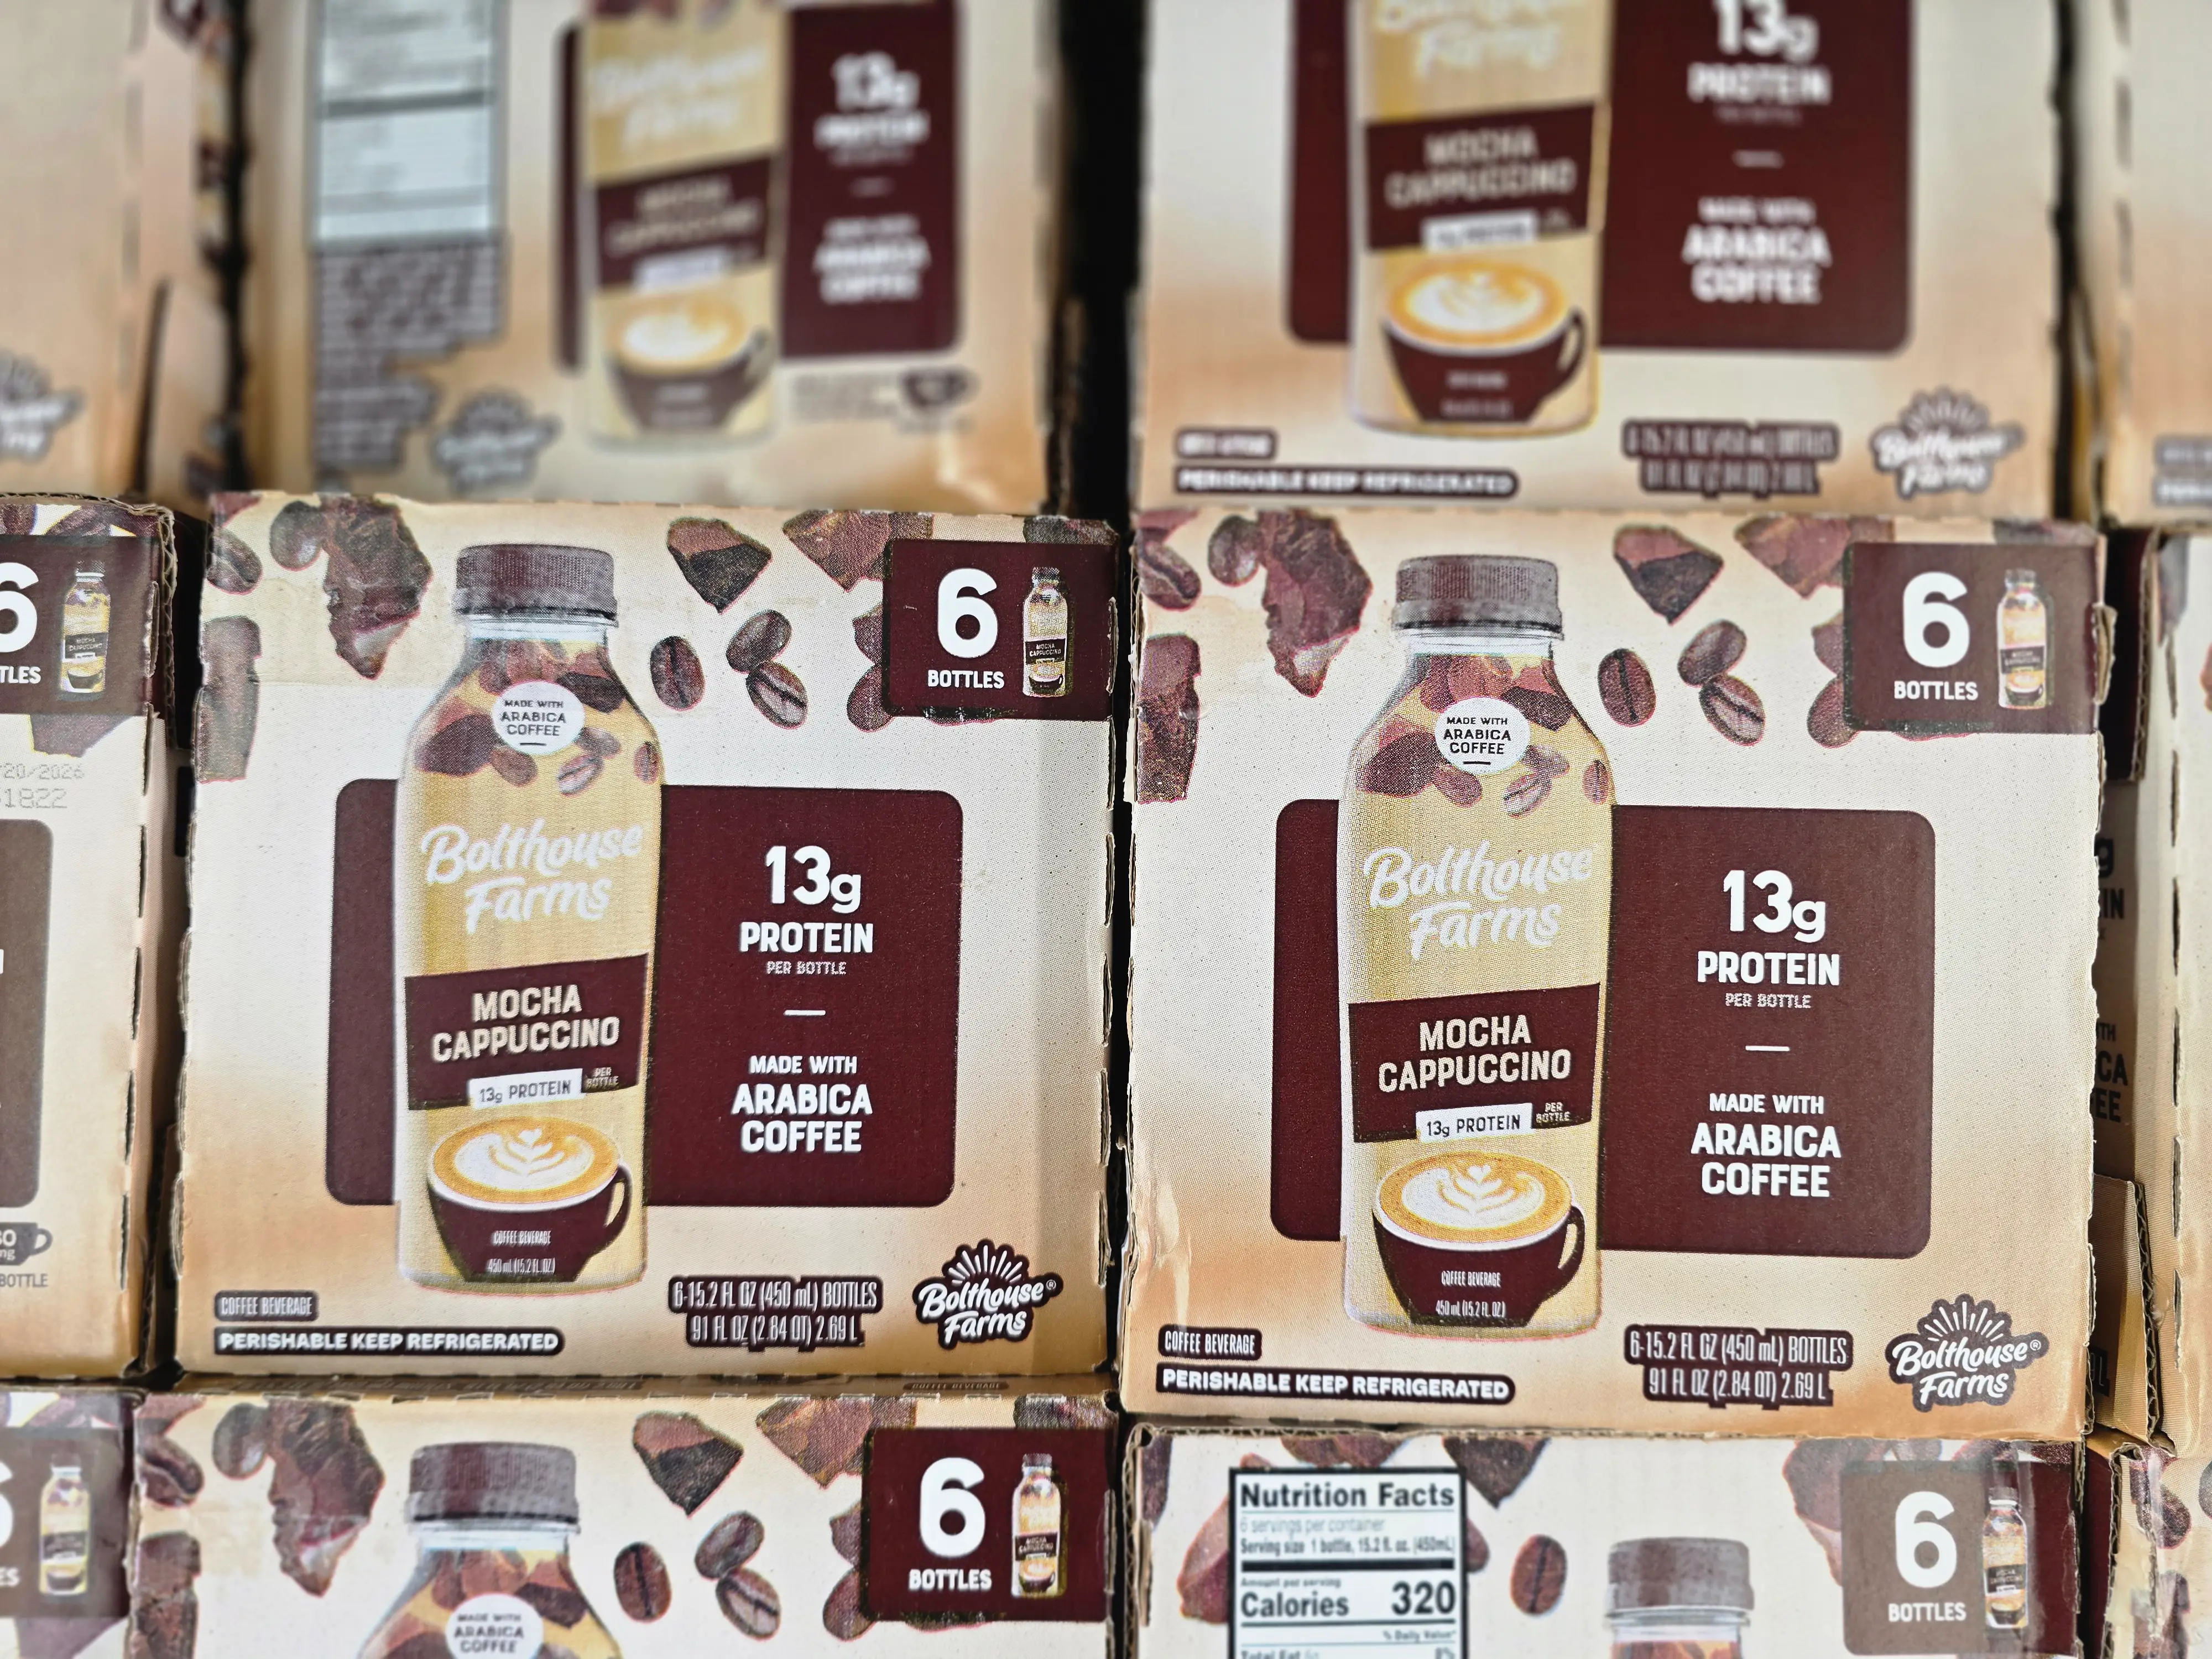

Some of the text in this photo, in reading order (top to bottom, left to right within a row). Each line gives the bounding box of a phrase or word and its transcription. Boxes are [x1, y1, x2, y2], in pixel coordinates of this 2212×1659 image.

[1714, 0, 1818, 62] 13g
[1688, 62, 1831, 105] PROTEIN
[938, 567, 998, 659] 6
[1903, 571, 1970, 667] 6
[928, 670, 1005, 689] BOTTLES
[1894, 681, 1979, 700] BOTTLES
[500, 712, 566, 723] ARABICA
[507, 725, 560, 736] COFFEE
[1447, 717, 1475, 725] MADE
[1443, 729, 1511, 742] ARABICA
[1449, 742, 1504, 755] COFFEE
[0, 763, 85, 779] 20/2026
[0, 789, 67, 808] 1822
[421, 818, 643, 884] Bolthouse
[765, 846, 861, 914] 13g
[1364, 839, 1593, 909] Bolthouse
[465, 877, 612, 935] Farms
[1723, 870, 1825, 943] 13g
[740, 922, 873, 953] PROTEIN
[1409, 900, 1562, 960] Farms
[767, 961, 847, 975] PER BOTTLE
[1698, 951, 1840, 985] PROTEIN
[472, 984, 582, 1022] MOCHA
[1725, 993, 1811, 1008] PER BOTTLE
[431, 1016, 620, 1062] CAPPUCCINO
[1420, 1014, 1532, 1051] MOCHA
[750, 1055, 857, 1074] MADE WITH
[1379, 1048, 1571, 1093] CAPPUCCINO
[479, 1079, 571, 1103] 13g PROTEIN
[731, 1083, 873, 1115] ARABICA
[1709, 1093, 1824, 1114] MADE WITH
[1536, 1111, 1571, 1123] BOTTLE
[1545, 1102, 1563, 1112] PER
[742, 1120, 862, 1153] COFFEE
[1427, 1114, 1520, 1138] 13g PROTEIN
[1691, 1123, 1841, 1158] ARABICA
[1702, 1162, 1830, 1197] COFFEE
[493, 1230, 518, 1245] COFFEE
[1441, 1271, 1501, 1287] COFFEE BEVERAGE
[221, 1297, 313, 1317] COFFEE BEVERAGE
[672, 1281, 718, 1308] 6-15.2
[720, 1281, 735, 1309] FL
[759, 1281, 791, 1313] (450
[821, 1281, 877, 1310] BOTTLES
[1436, 1300, 1449, 1316] 450
[1451, 1301, 1461, 1316] mL
[1462, 1300, 1480, 1318] (15.2
[221, 1332, 559, 1350] PERISHABLE KEEP REFRIGERATED
[690, 1315, 708, 1342] 91
[712, 1316, 727, 1342] FL
[815, 1316, 846, 1341] 2.69
[944, 1310, 1027, 1345] Farms
[1165, 1331, 1255, 1355] COFFEE BEVERAGE
[1630, 1331, 1676, 1359] 6-15.2
[1681, 1333, 1695, 1359] FL
[1722, 1334, 1754, 1365] (450
[1759, 1335, 1783, 1366] mL)
[1788, 1336, 1847, 1364] BOTTLES
[1163, 1369, 1510, 1399] PERISHABLE KEEP REFRIGERATED
[1649, 1368, 1666, 1395] 91
[1672, 1368, 1687, 1396] FL
[1692, 1369, 1709, 1396] OZ
[1713, 1370, 1750, 1401] (2.84
[1781, 1371, 1813, 1398] 2.69
[1818, 1373, 1826, 1400] L
[1919, 1370, 2009, 1404] Farms
[920, 1457, 985, 1558] 6
[1241, 1482, 1454, 1507] Nutrition Facts
[1241, 1537, 1280, 1557] Serving
[1896, 1491, 1957, 1588] 6
[909, 1569, 992, 1591] BOTTLES
[1240, 1580, 1457, 1618] Calories 320
[1888, 1603, 1966, 1623] BOTTLES
[455, 1626, 524, 1638] ARABICA
[460, 1640, 517, 1653] COFFEE
